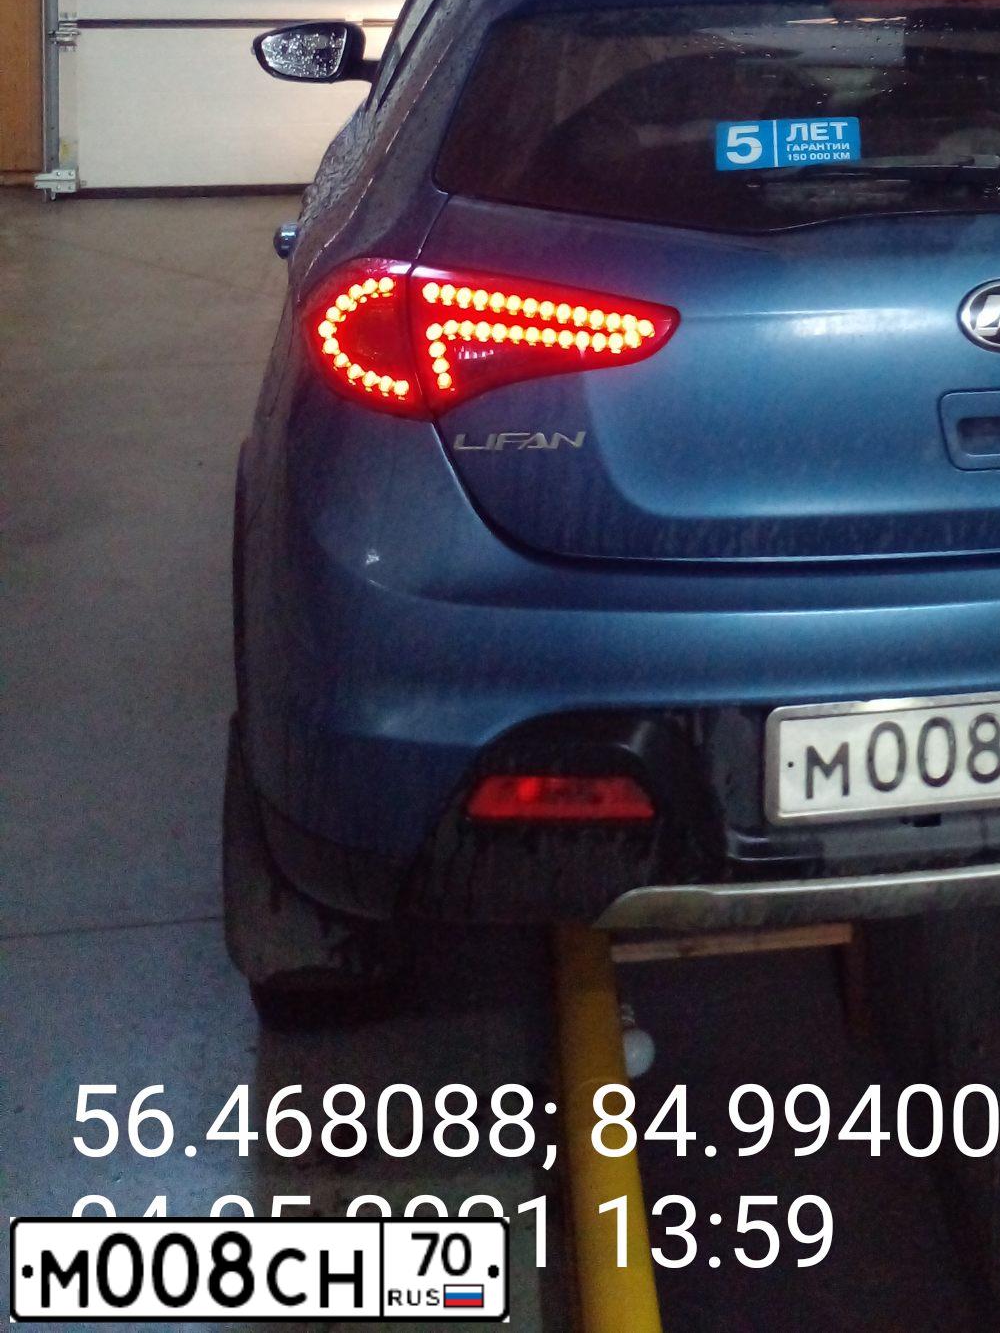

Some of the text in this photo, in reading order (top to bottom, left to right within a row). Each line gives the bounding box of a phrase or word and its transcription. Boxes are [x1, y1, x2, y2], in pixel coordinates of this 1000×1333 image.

[785, 122, 848, 142] ЛЕТ
[726, 125, 762, 164] 5
[786, 142, 850, 152] ГАРАНТИИ
[788, 152, 851, 161] 150 000 КМ
[453, 430, 586, 451] LIFAN
